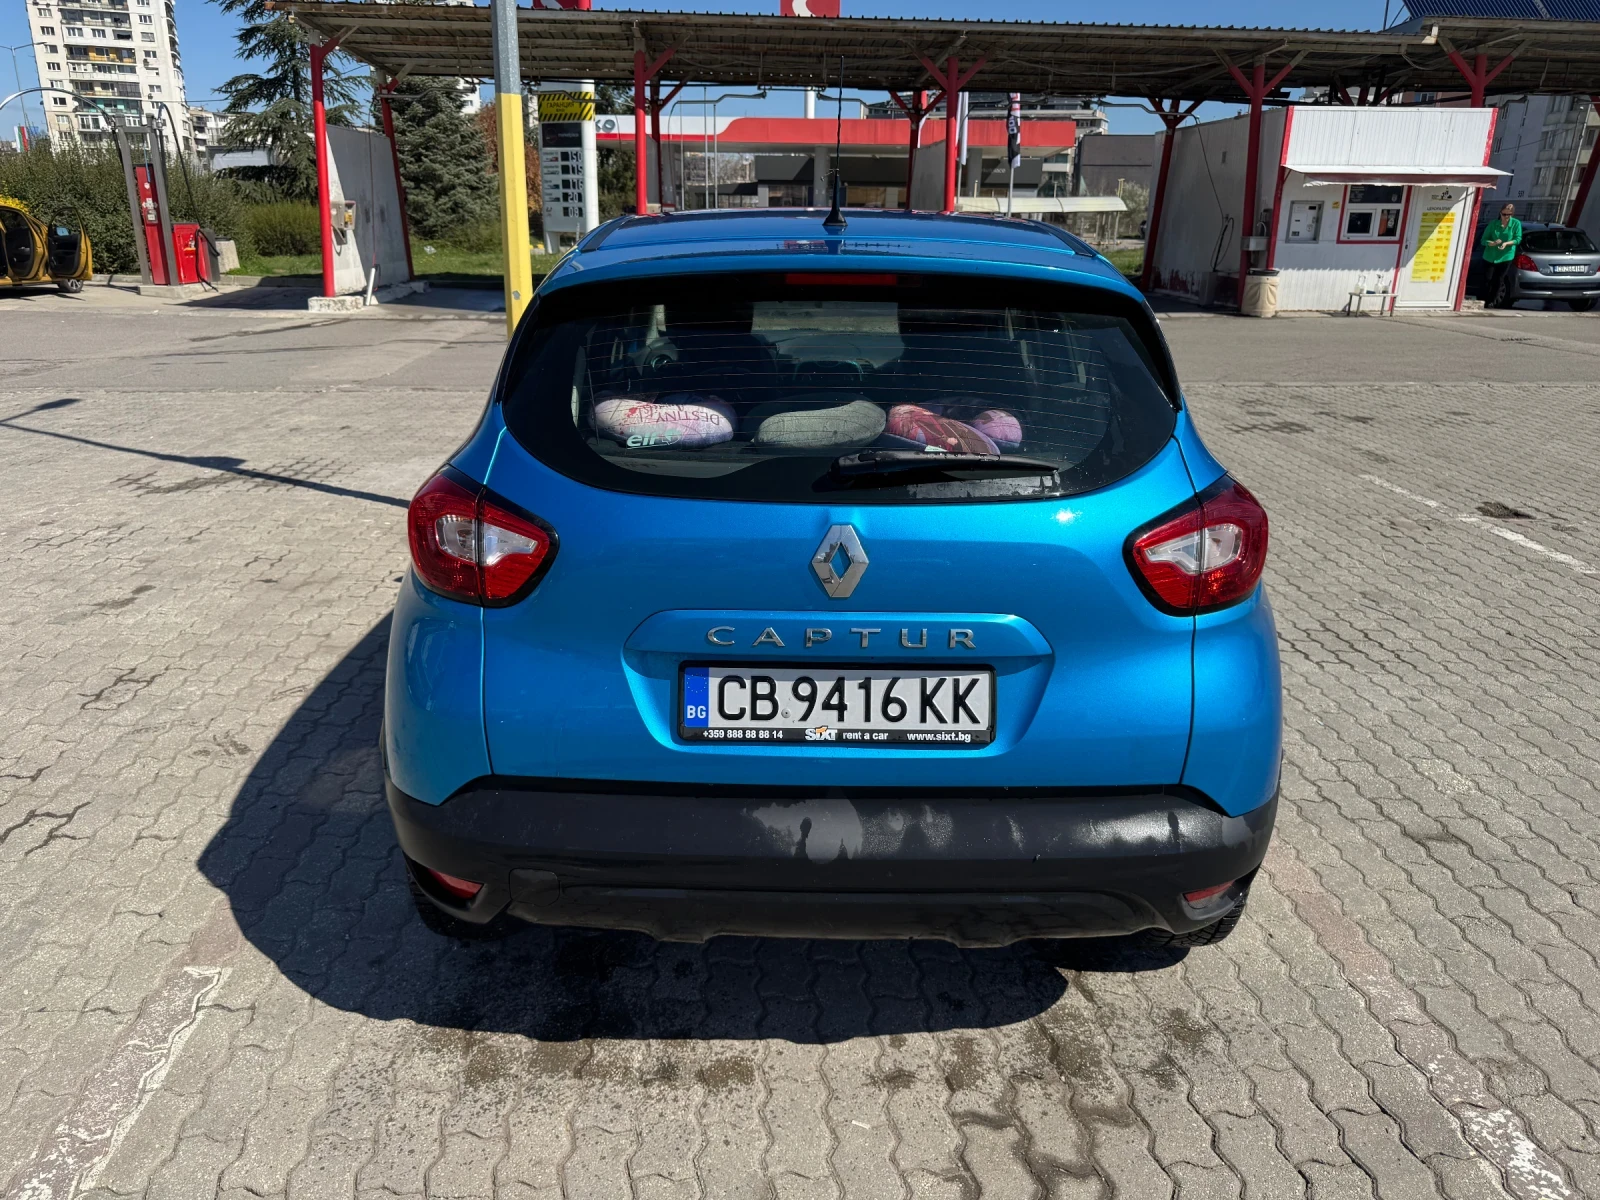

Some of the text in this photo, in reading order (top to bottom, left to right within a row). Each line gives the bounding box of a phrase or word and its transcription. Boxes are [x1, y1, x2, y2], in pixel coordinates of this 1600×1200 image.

[655, 410, 720, 426] DESTINY
[706, 625, 977, 649] CAPTUR
[717, 675, 982, 725] CB 9416 KK
[686, 705, 707, 719] BG
[702, 729, 725, 739] +359
[726, 729, 743, 739] 888
[745, 729, 757, 739] 88
[758, 730, 770, 739] 88
[771, 730, 784, 739] 14
[842, 731, 862, 740] rent
[863, 732, 870, 740] a
[872, 732, 889, 740] car
[906, 732, 971, 743] www.sixt.bg
